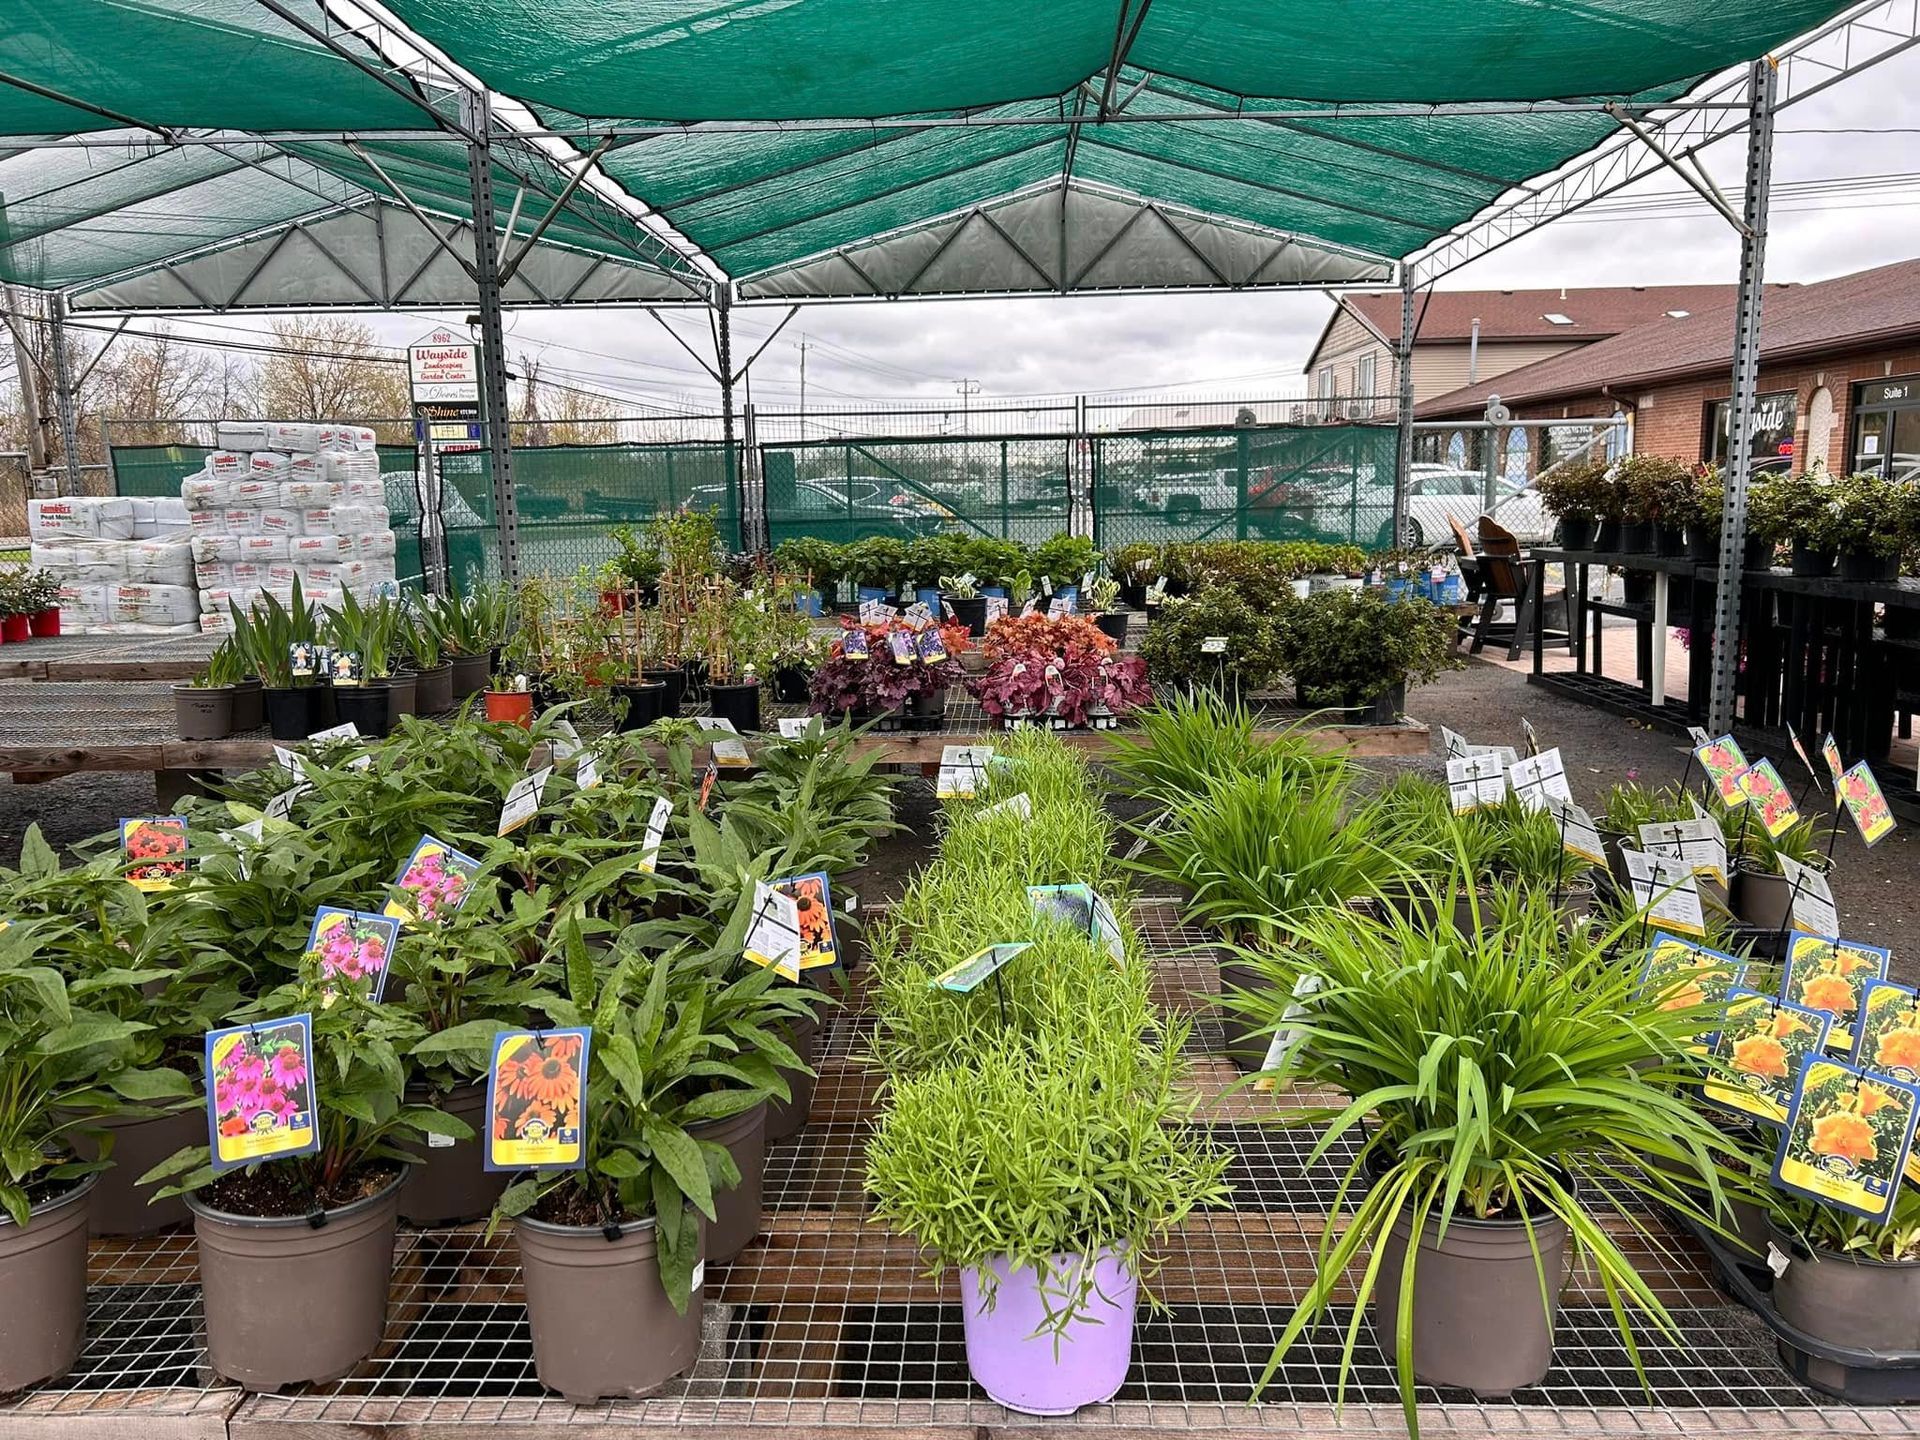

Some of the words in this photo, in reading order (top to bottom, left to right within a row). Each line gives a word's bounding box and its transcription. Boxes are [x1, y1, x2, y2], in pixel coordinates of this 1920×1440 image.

[432, 333, 451, 343] 8962
[416, 348, 468, 362] Wayside
[1884, 387, 1903, 400] Suite
[1904, 385, 1909, 397] 1
